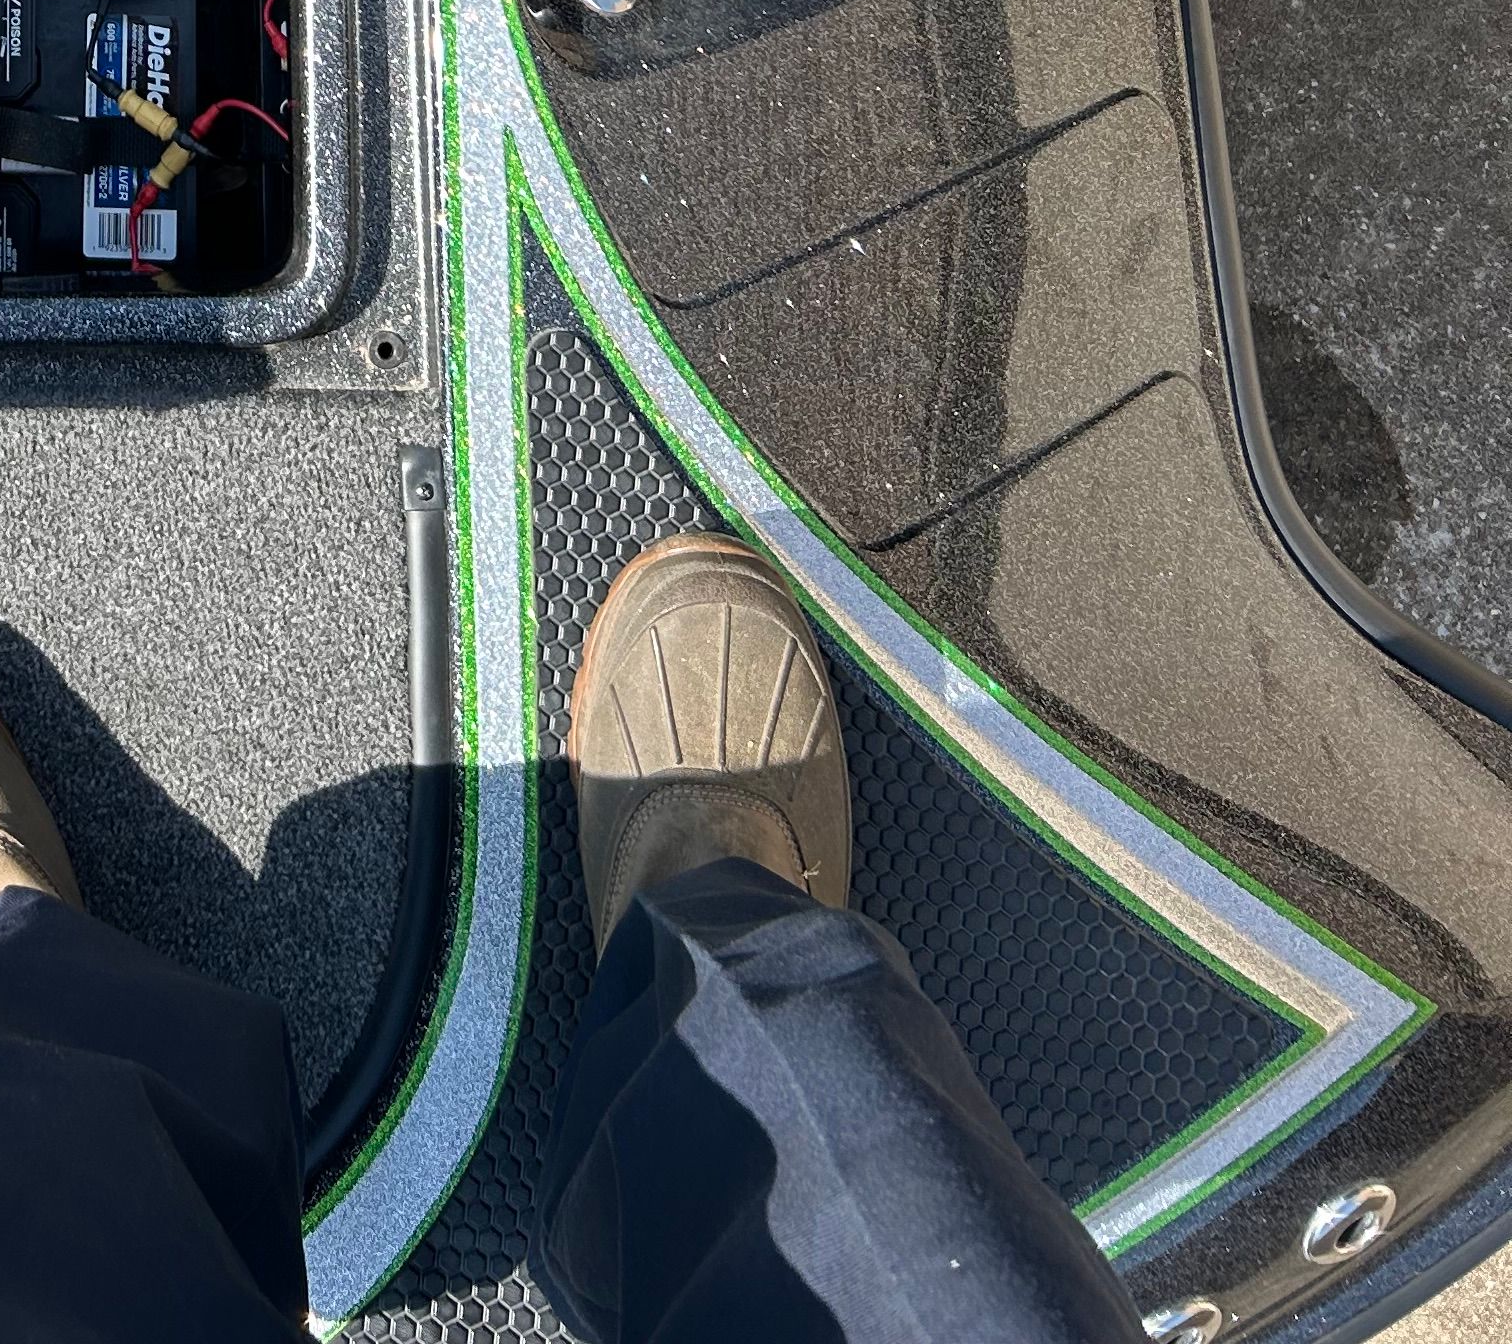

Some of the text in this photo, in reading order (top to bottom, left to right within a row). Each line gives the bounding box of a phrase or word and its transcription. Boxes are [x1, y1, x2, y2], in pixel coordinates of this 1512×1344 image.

[11, 8, 22, 57] POISON
[106, 23, 116, 41] 600
[106, 69, 115, 81] 75
[147, 25, 172, 110] DieHa
[118, 165, 129, 201] ILVER
